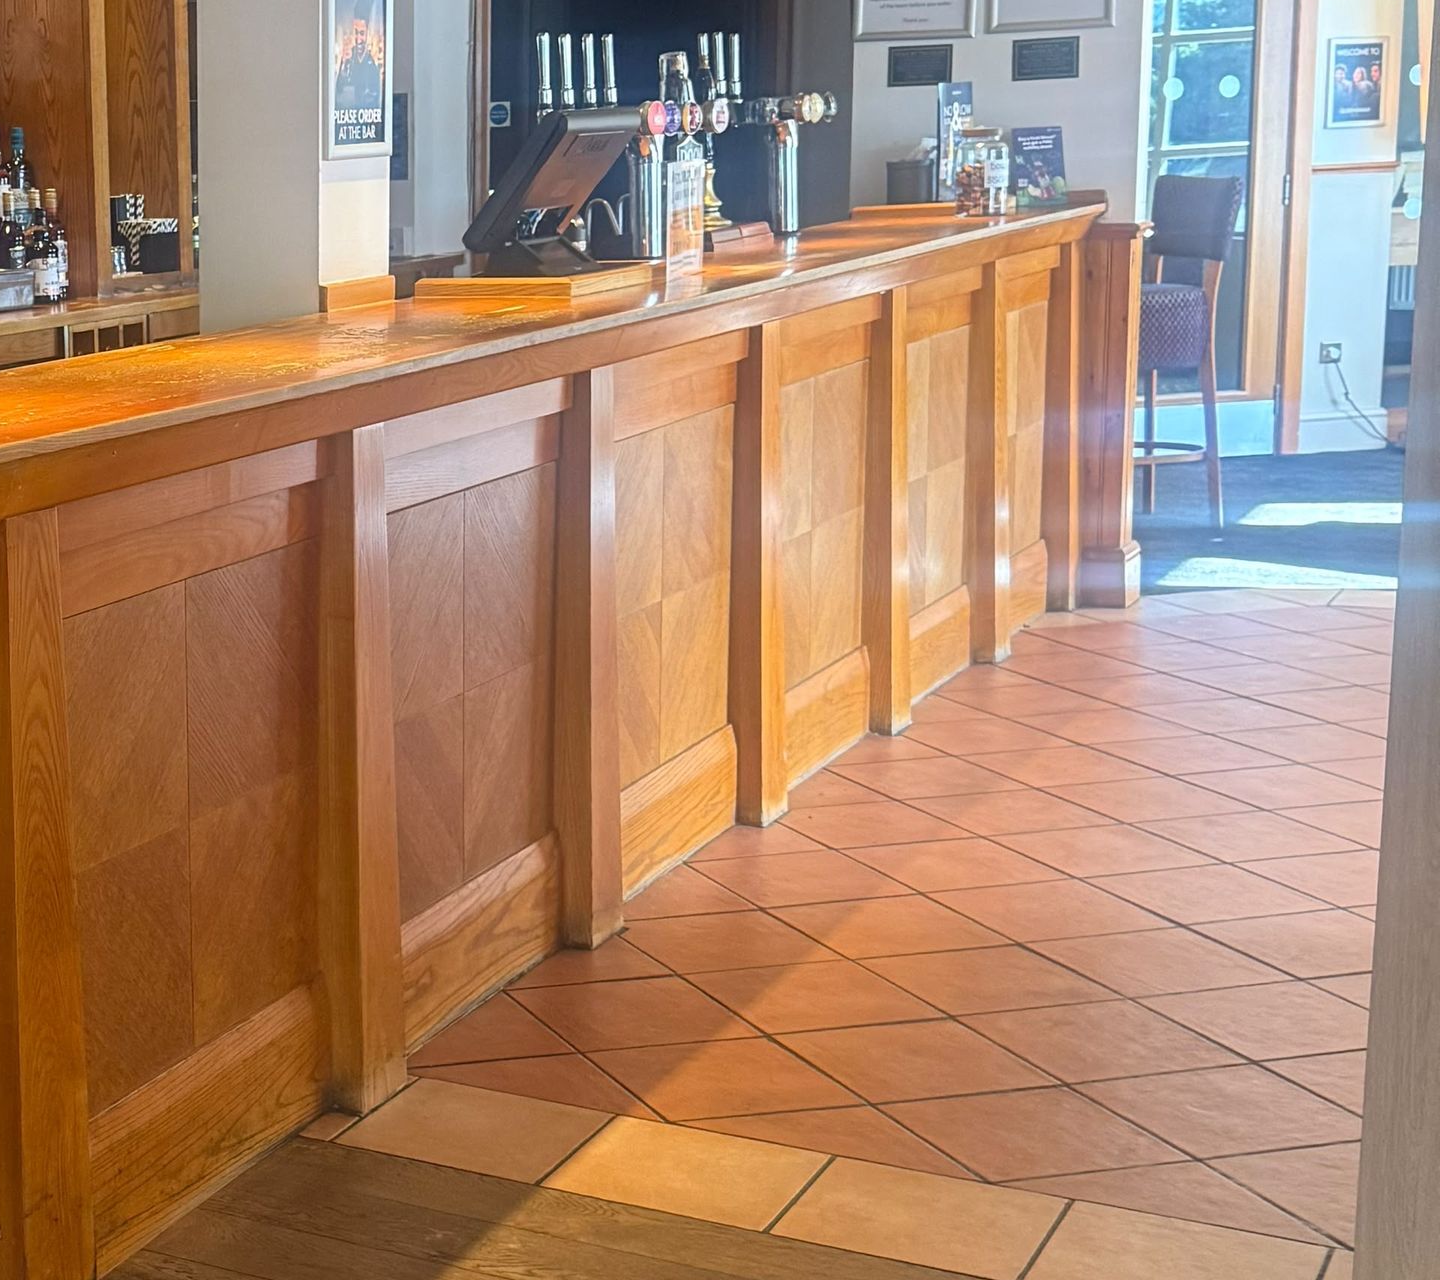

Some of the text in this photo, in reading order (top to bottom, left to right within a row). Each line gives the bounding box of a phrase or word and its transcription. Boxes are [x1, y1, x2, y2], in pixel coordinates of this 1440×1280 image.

[334, 108, 382, 124] PLEASE ORDER
[339, 125, 376, 140] AT THE BAR
